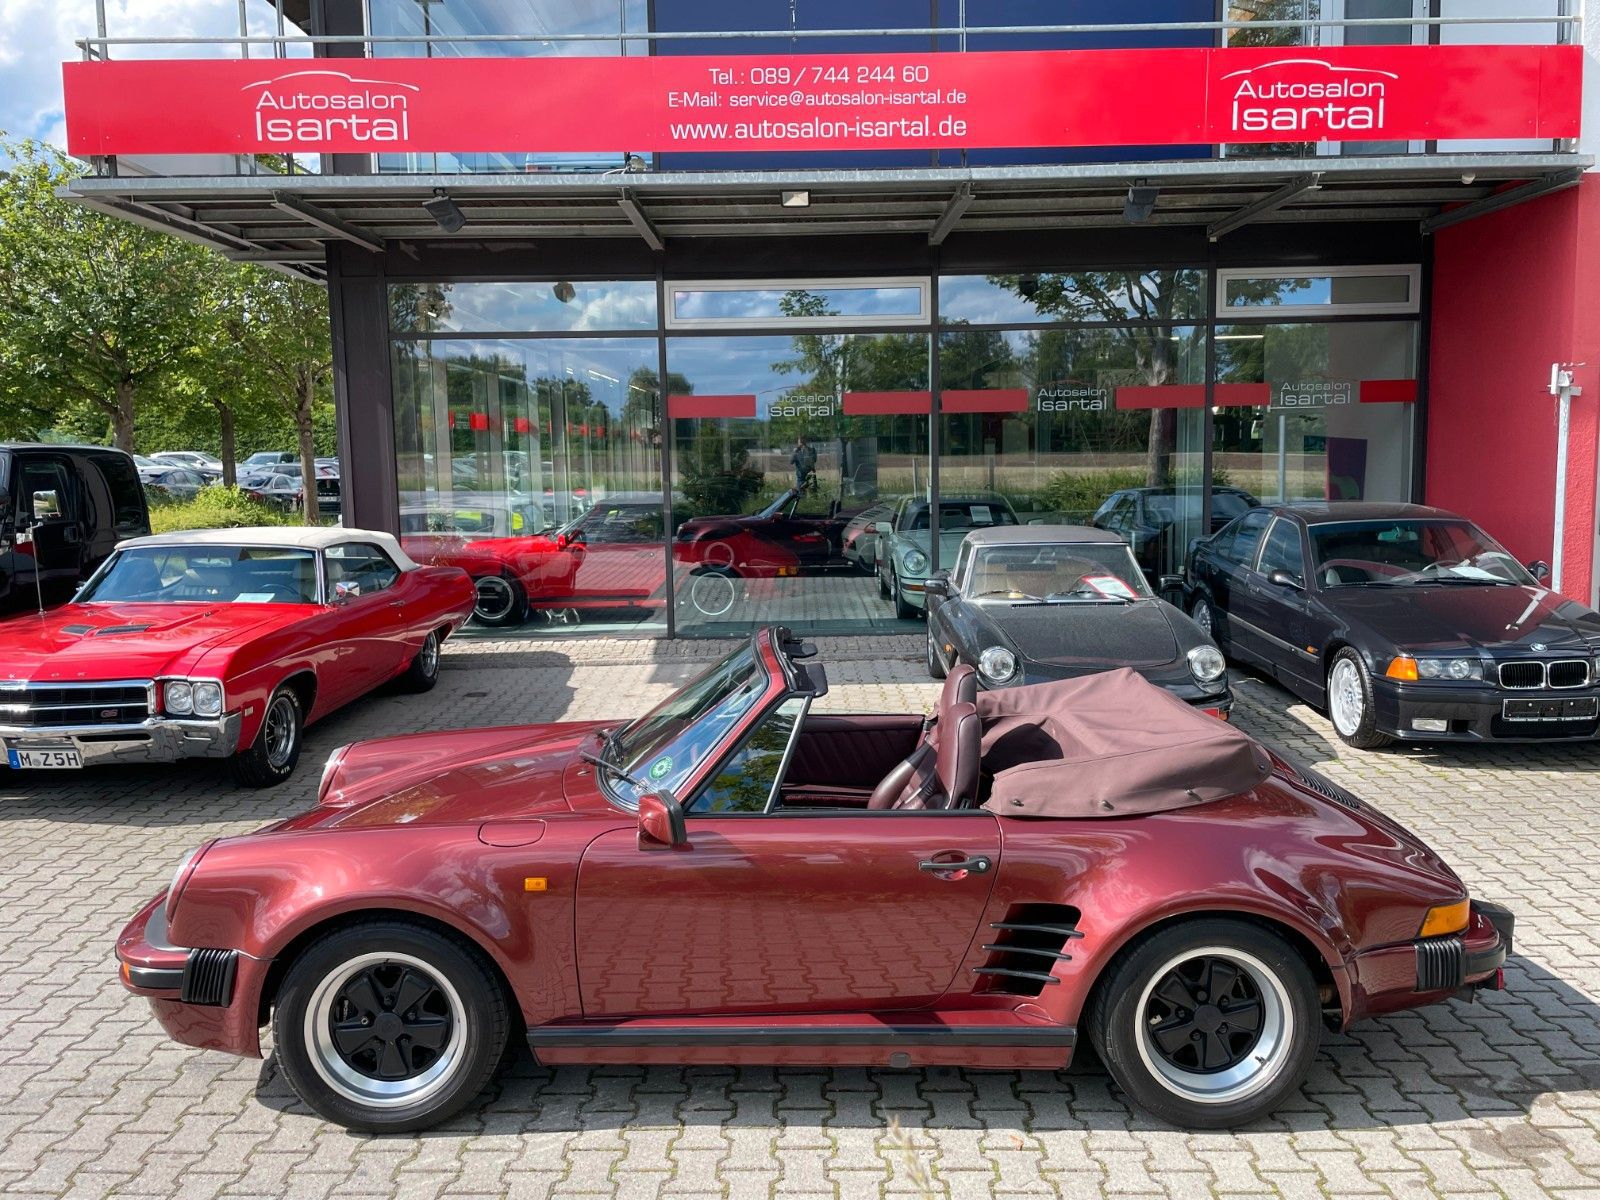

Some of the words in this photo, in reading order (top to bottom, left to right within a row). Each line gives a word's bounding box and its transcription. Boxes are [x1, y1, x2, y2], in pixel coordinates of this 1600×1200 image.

[707, 67, 745, 85] Tel.:
[857, 66, 896, 83] 244
[902, 65, 929, 83] 60
[668, 91, 723, 107] E-Mail:
[729, 88, 967, 107] service@autosalon-isartal.de
[1234, 78, 1386, 99] Autosalon
[256, 90, 408, 110] Autosalon
[1231, 98, 1386, 131] Isartal
[255, 110, 409, 142] Isartal
[669, 114, 967, 140] www.autosalon-isartal.de
[1037, 387, 1107, 397] Autosalon
[1281, 381, 1351, 391] Autosalon
[1037, 396, 1107, 412] Isartal
[1280, 389, 1351, 406] Isartal
